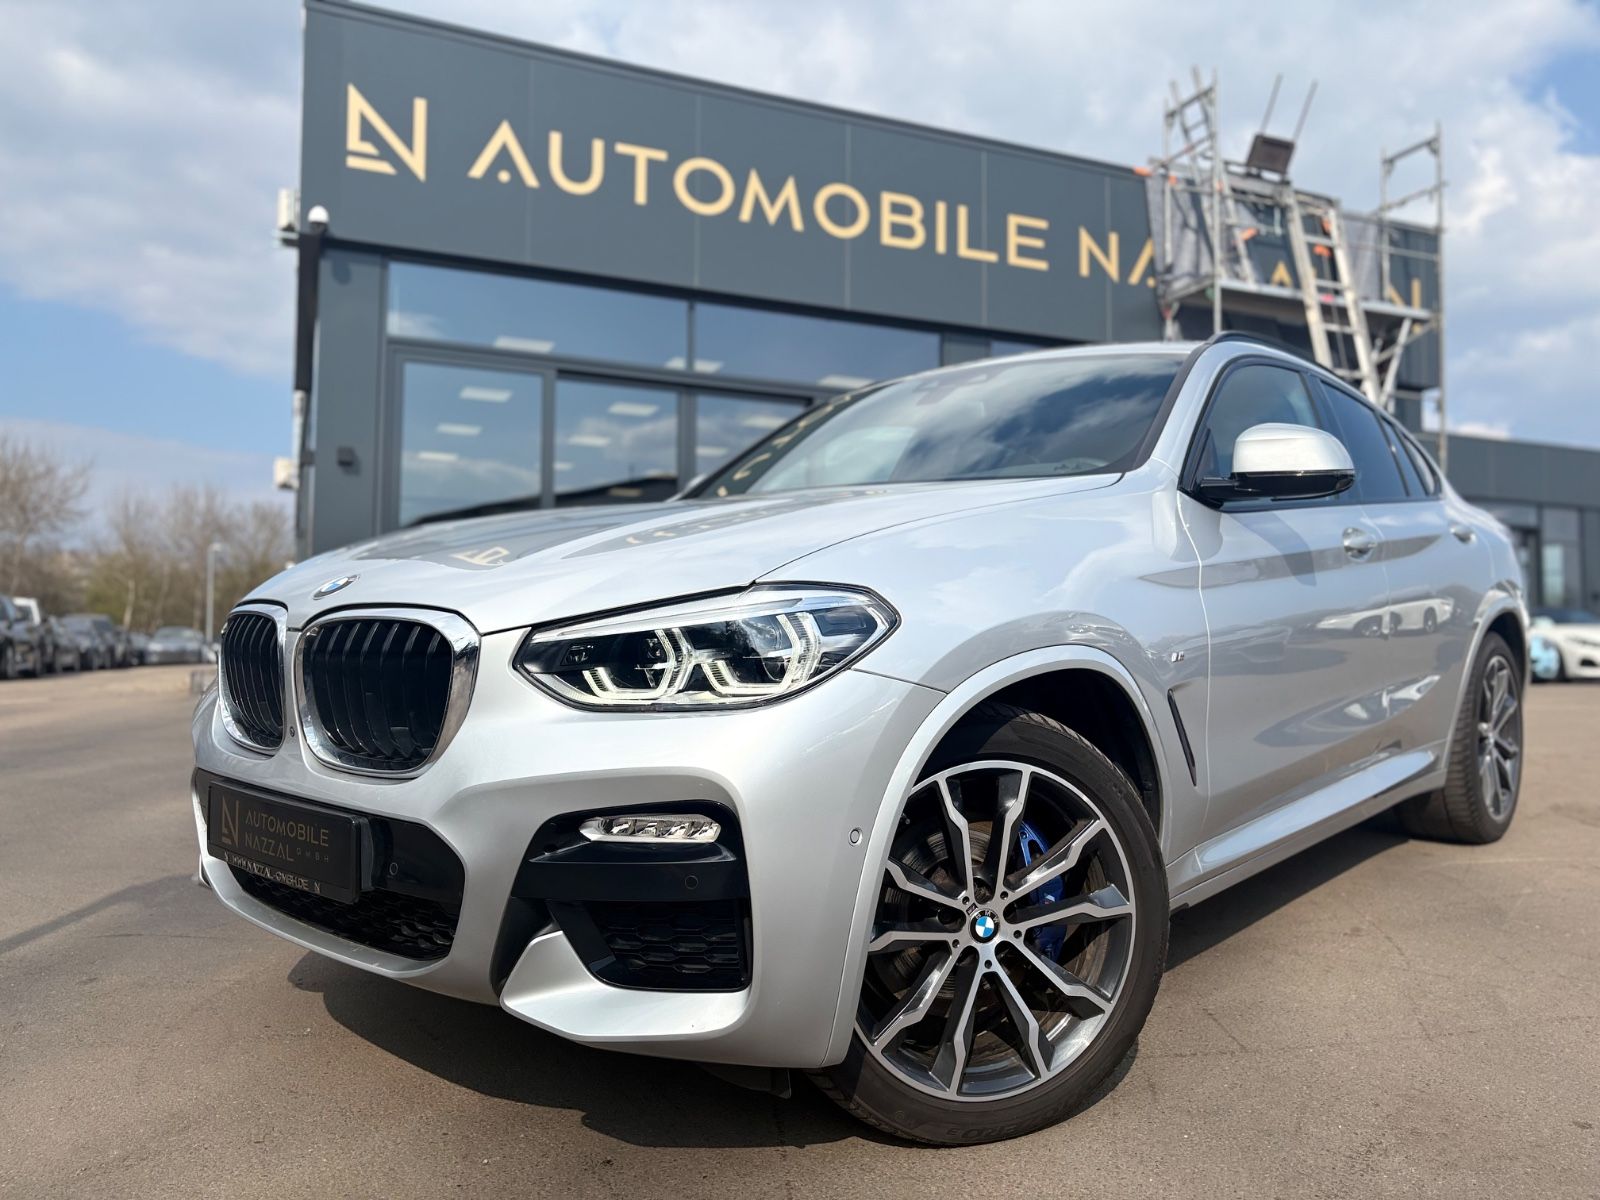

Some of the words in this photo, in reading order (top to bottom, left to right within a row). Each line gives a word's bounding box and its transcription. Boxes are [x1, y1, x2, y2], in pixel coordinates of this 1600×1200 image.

[468, 120, 1049, 271] AUTOMOBILE
[244, 832, 295, 862] NAZZAL
[245, 809, 329, 847] AUTOMOBILE
